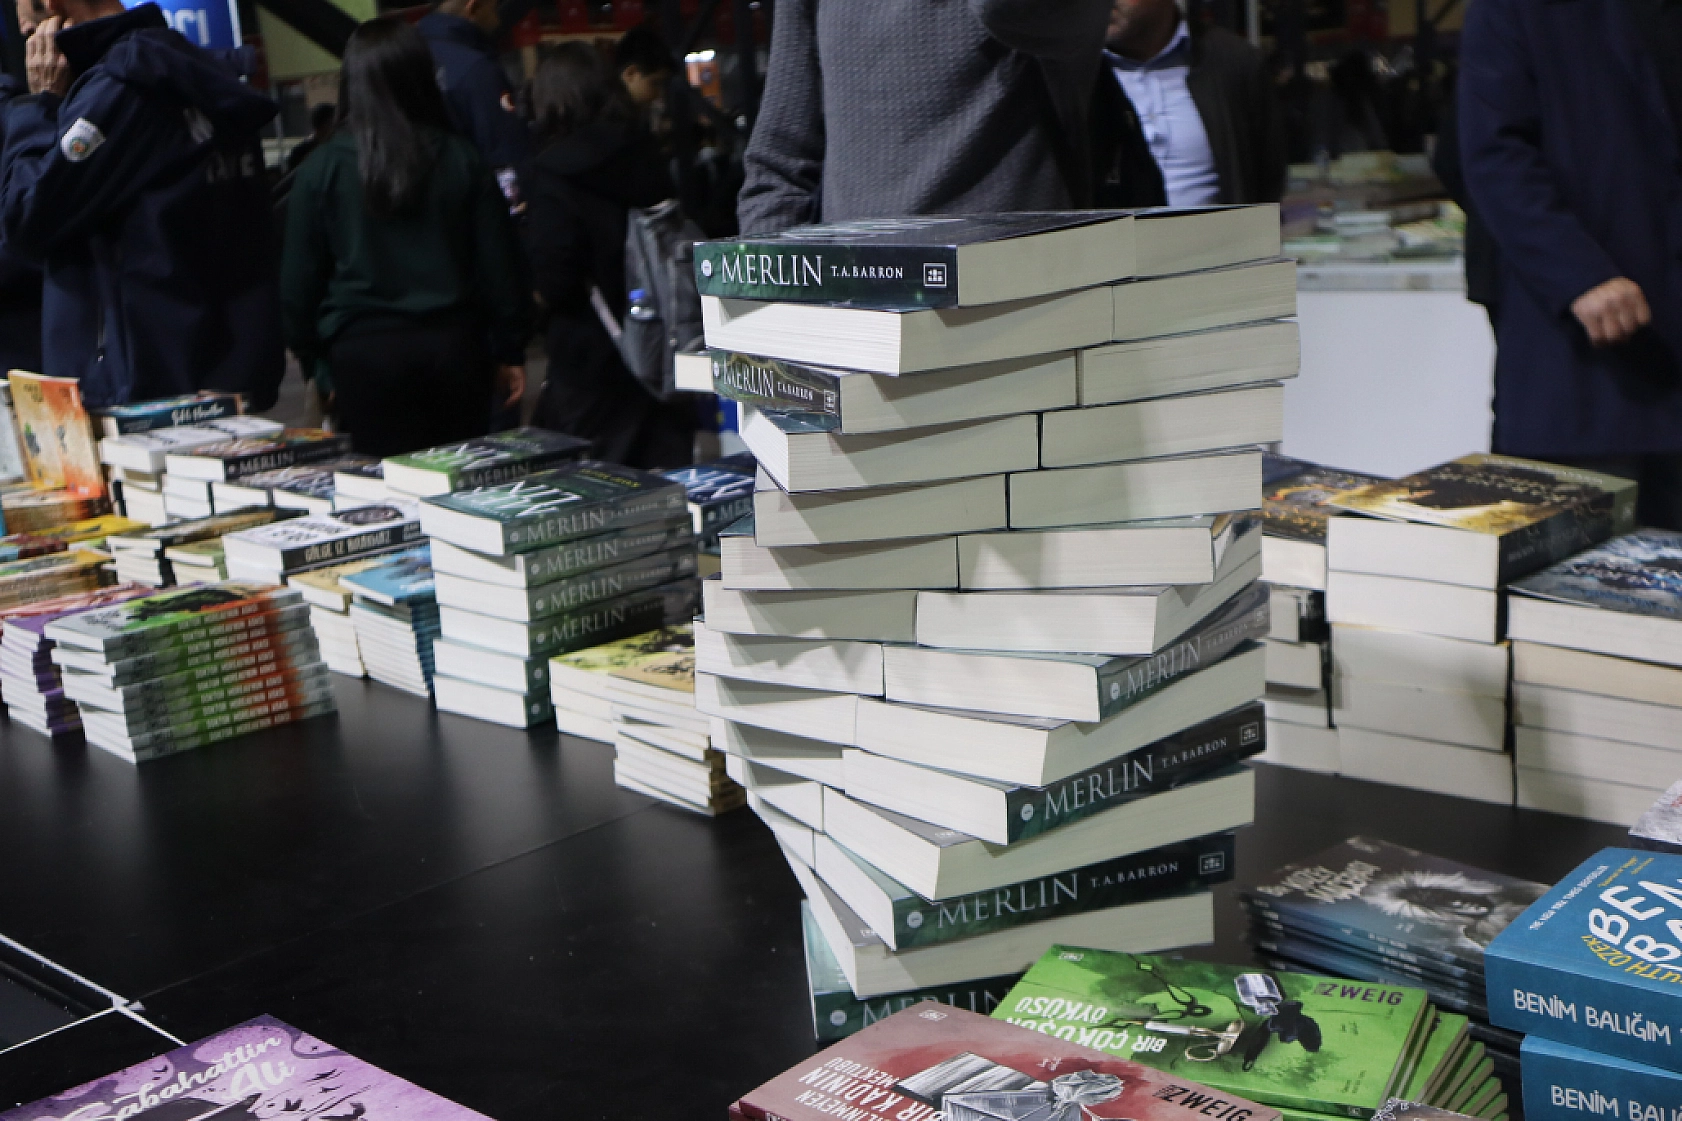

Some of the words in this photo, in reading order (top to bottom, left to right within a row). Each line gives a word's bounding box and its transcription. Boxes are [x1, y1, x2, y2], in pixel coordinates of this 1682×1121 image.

[721, 253, 823, 287] MERLIN
[723, 358, 774, 398] MERLIN
[527, 508, 605, 543] MERLIN
[547, 538, 619, 574] MERLIN
[550, 573, 622, 610] MERLIN
[551, 605, 625, 643] MERLIN
[1127, 636, 1200, 699] MERLIN
[1045, 754, 1153, 820] MERLIN
[937, 872, 1079, 928] MERLIN
[1322, 982, 1405, 1006] ZWEIG
[1513, 988, 1577, 1023] BENİM
[1585, 1005, 1672, 1046] BALIĞIM
[222, 1058, 296, 1100] Ali
[798, 1066, 905, 1112] KADININ
[824, 1056, 900, 1088] MEKTUBU
[1158, 1085, 1253, 1121] ZWEIG
[1551, 1084, 1620, 1118] BENİM
